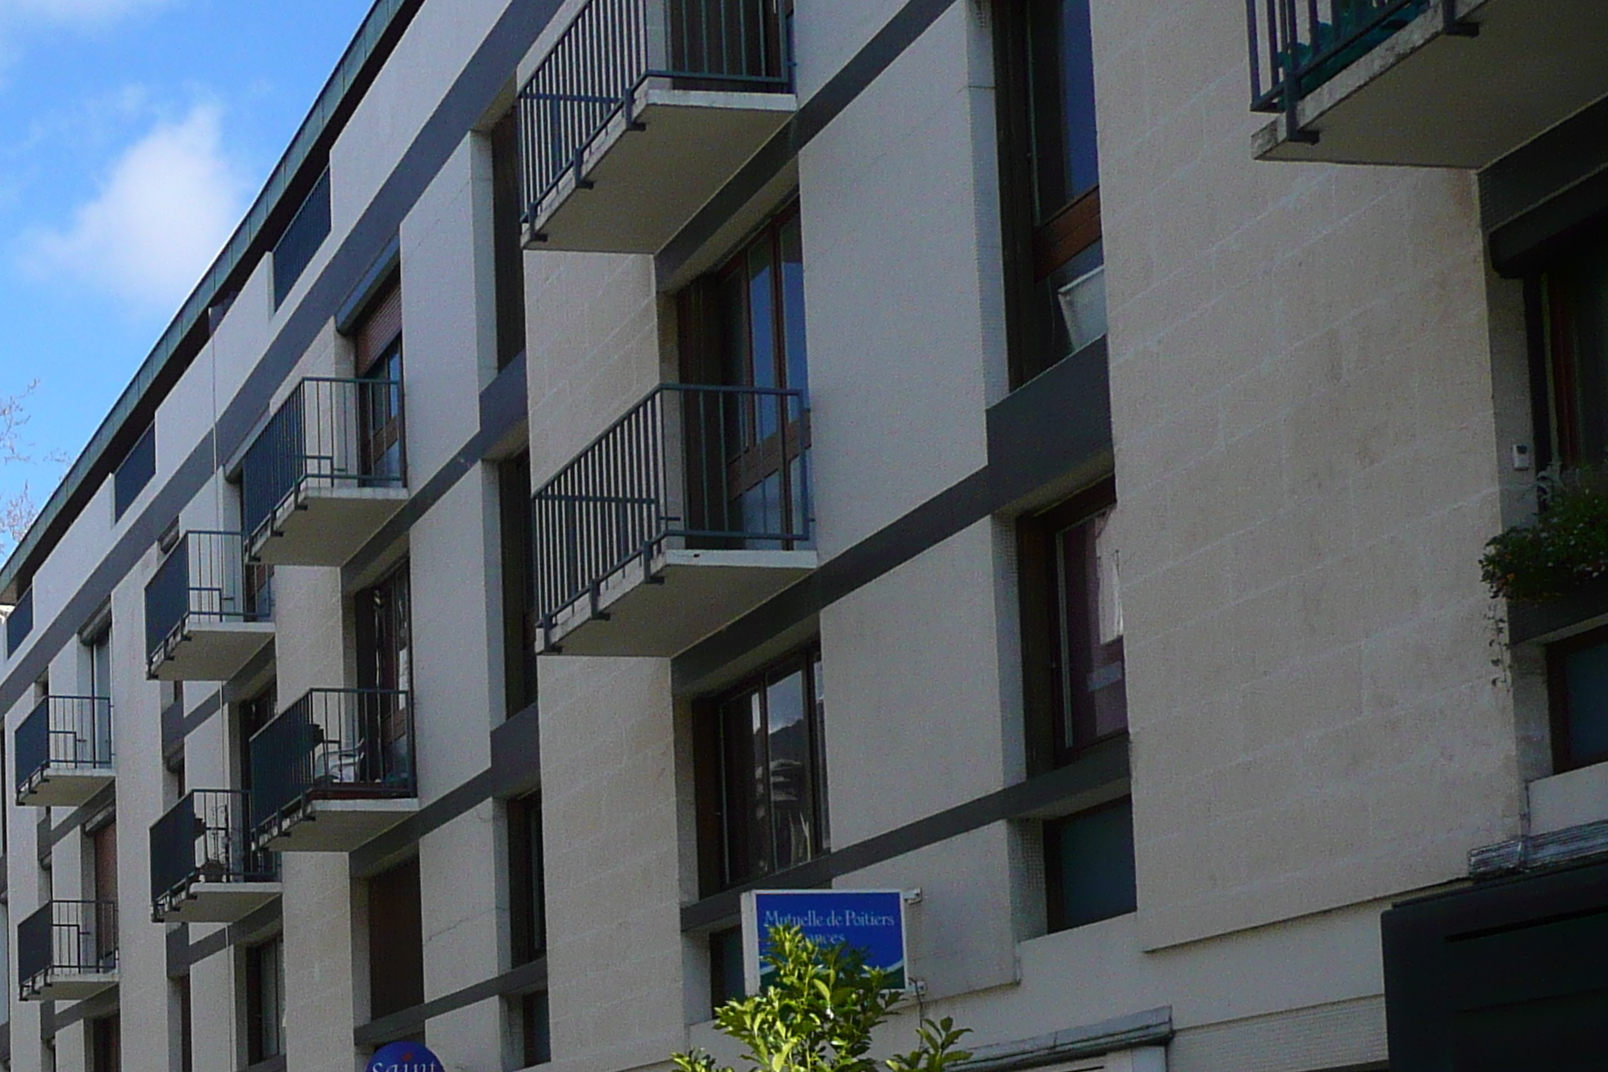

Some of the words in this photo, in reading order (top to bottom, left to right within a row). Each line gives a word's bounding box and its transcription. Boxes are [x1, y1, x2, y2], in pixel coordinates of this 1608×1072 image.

[764, 909, 824, 927] Mutuelle
[826, 910, 843, 926] de
[845, 909, 895, 926] Poitiers
